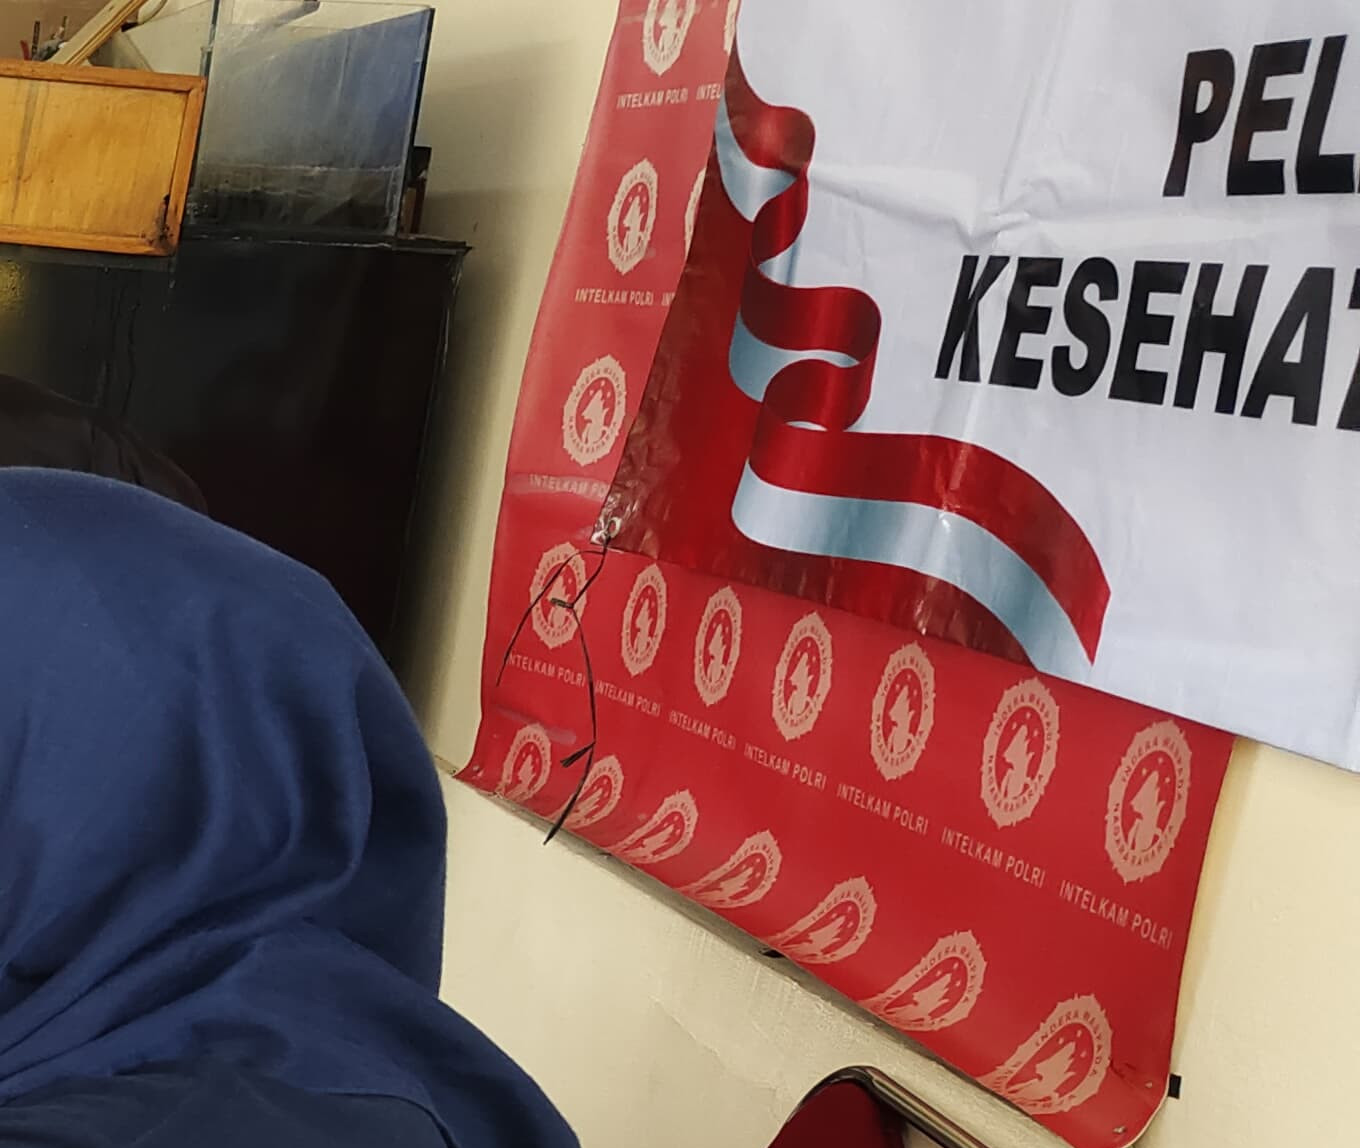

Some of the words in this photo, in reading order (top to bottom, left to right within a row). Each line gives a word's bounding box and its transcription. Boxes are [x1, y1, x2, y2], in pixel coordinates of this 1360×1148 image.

[696, 83, 722, 101] INTEL
[1162, 34, 1360, 197] PEL
[744, 742, 790, 776] INTELKAM
[791, 763, 827, 790] POLRI
[837, 783, 890, 819] INTELKAM
[891, 805, 929, 835] POLRI
[941, 826, 1004, 868] INTELKAM
[1005, 854, 1046, 889] POLRI
[1059, 879, 1128, 927] INTELKAM
[1130, 912, 1174, 950] POLRI
